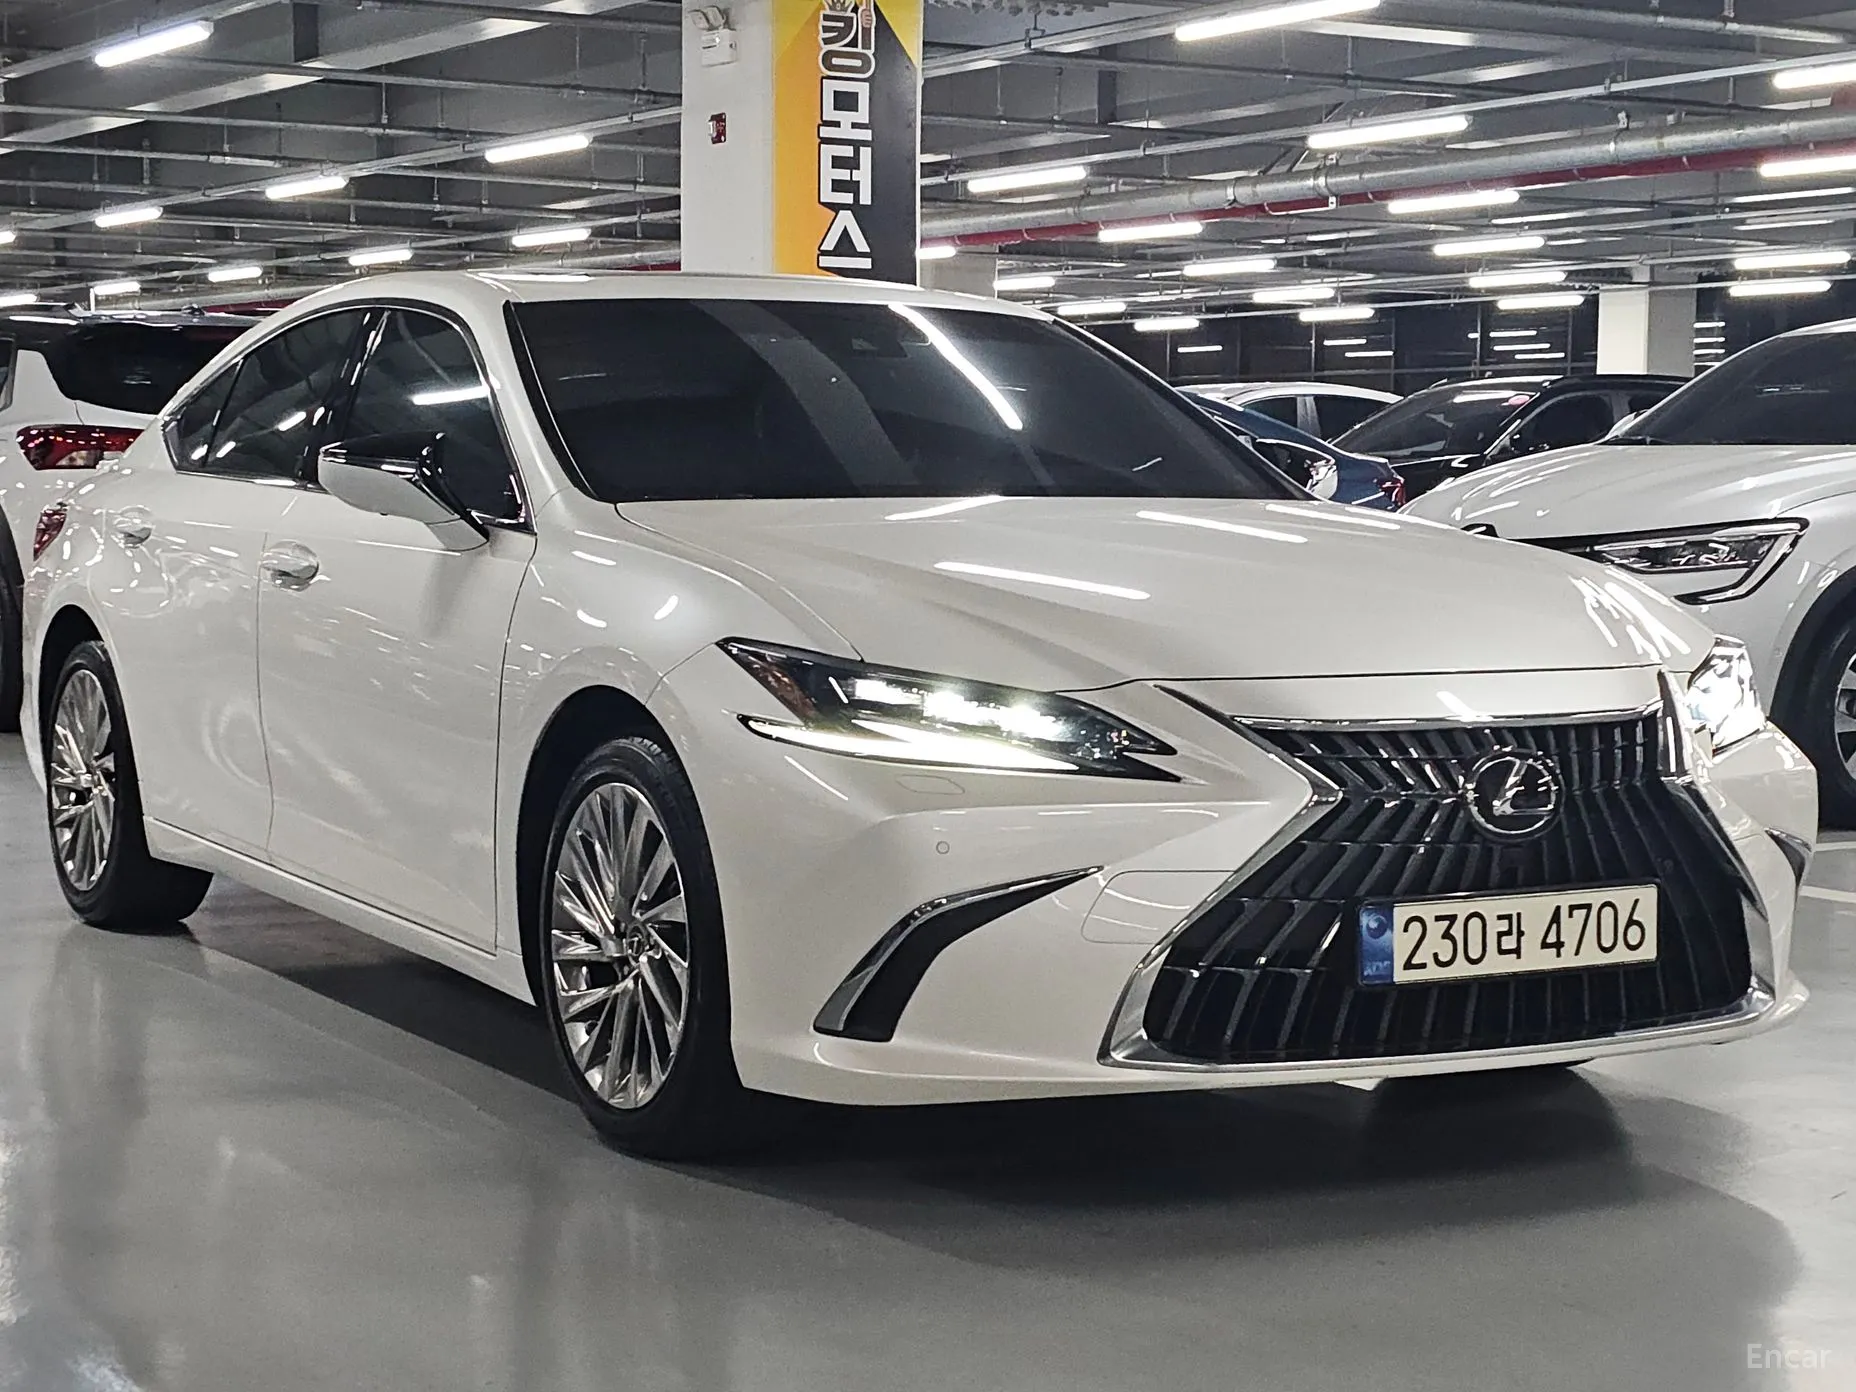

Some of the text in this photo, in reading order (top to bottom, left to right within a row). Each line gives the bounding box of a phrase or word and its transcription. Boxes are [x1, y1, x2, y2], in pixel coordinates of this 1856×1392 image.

[818, 9, 876, 269] 킹모터스
[1402, 898, 1646, 970] 230라 4706
